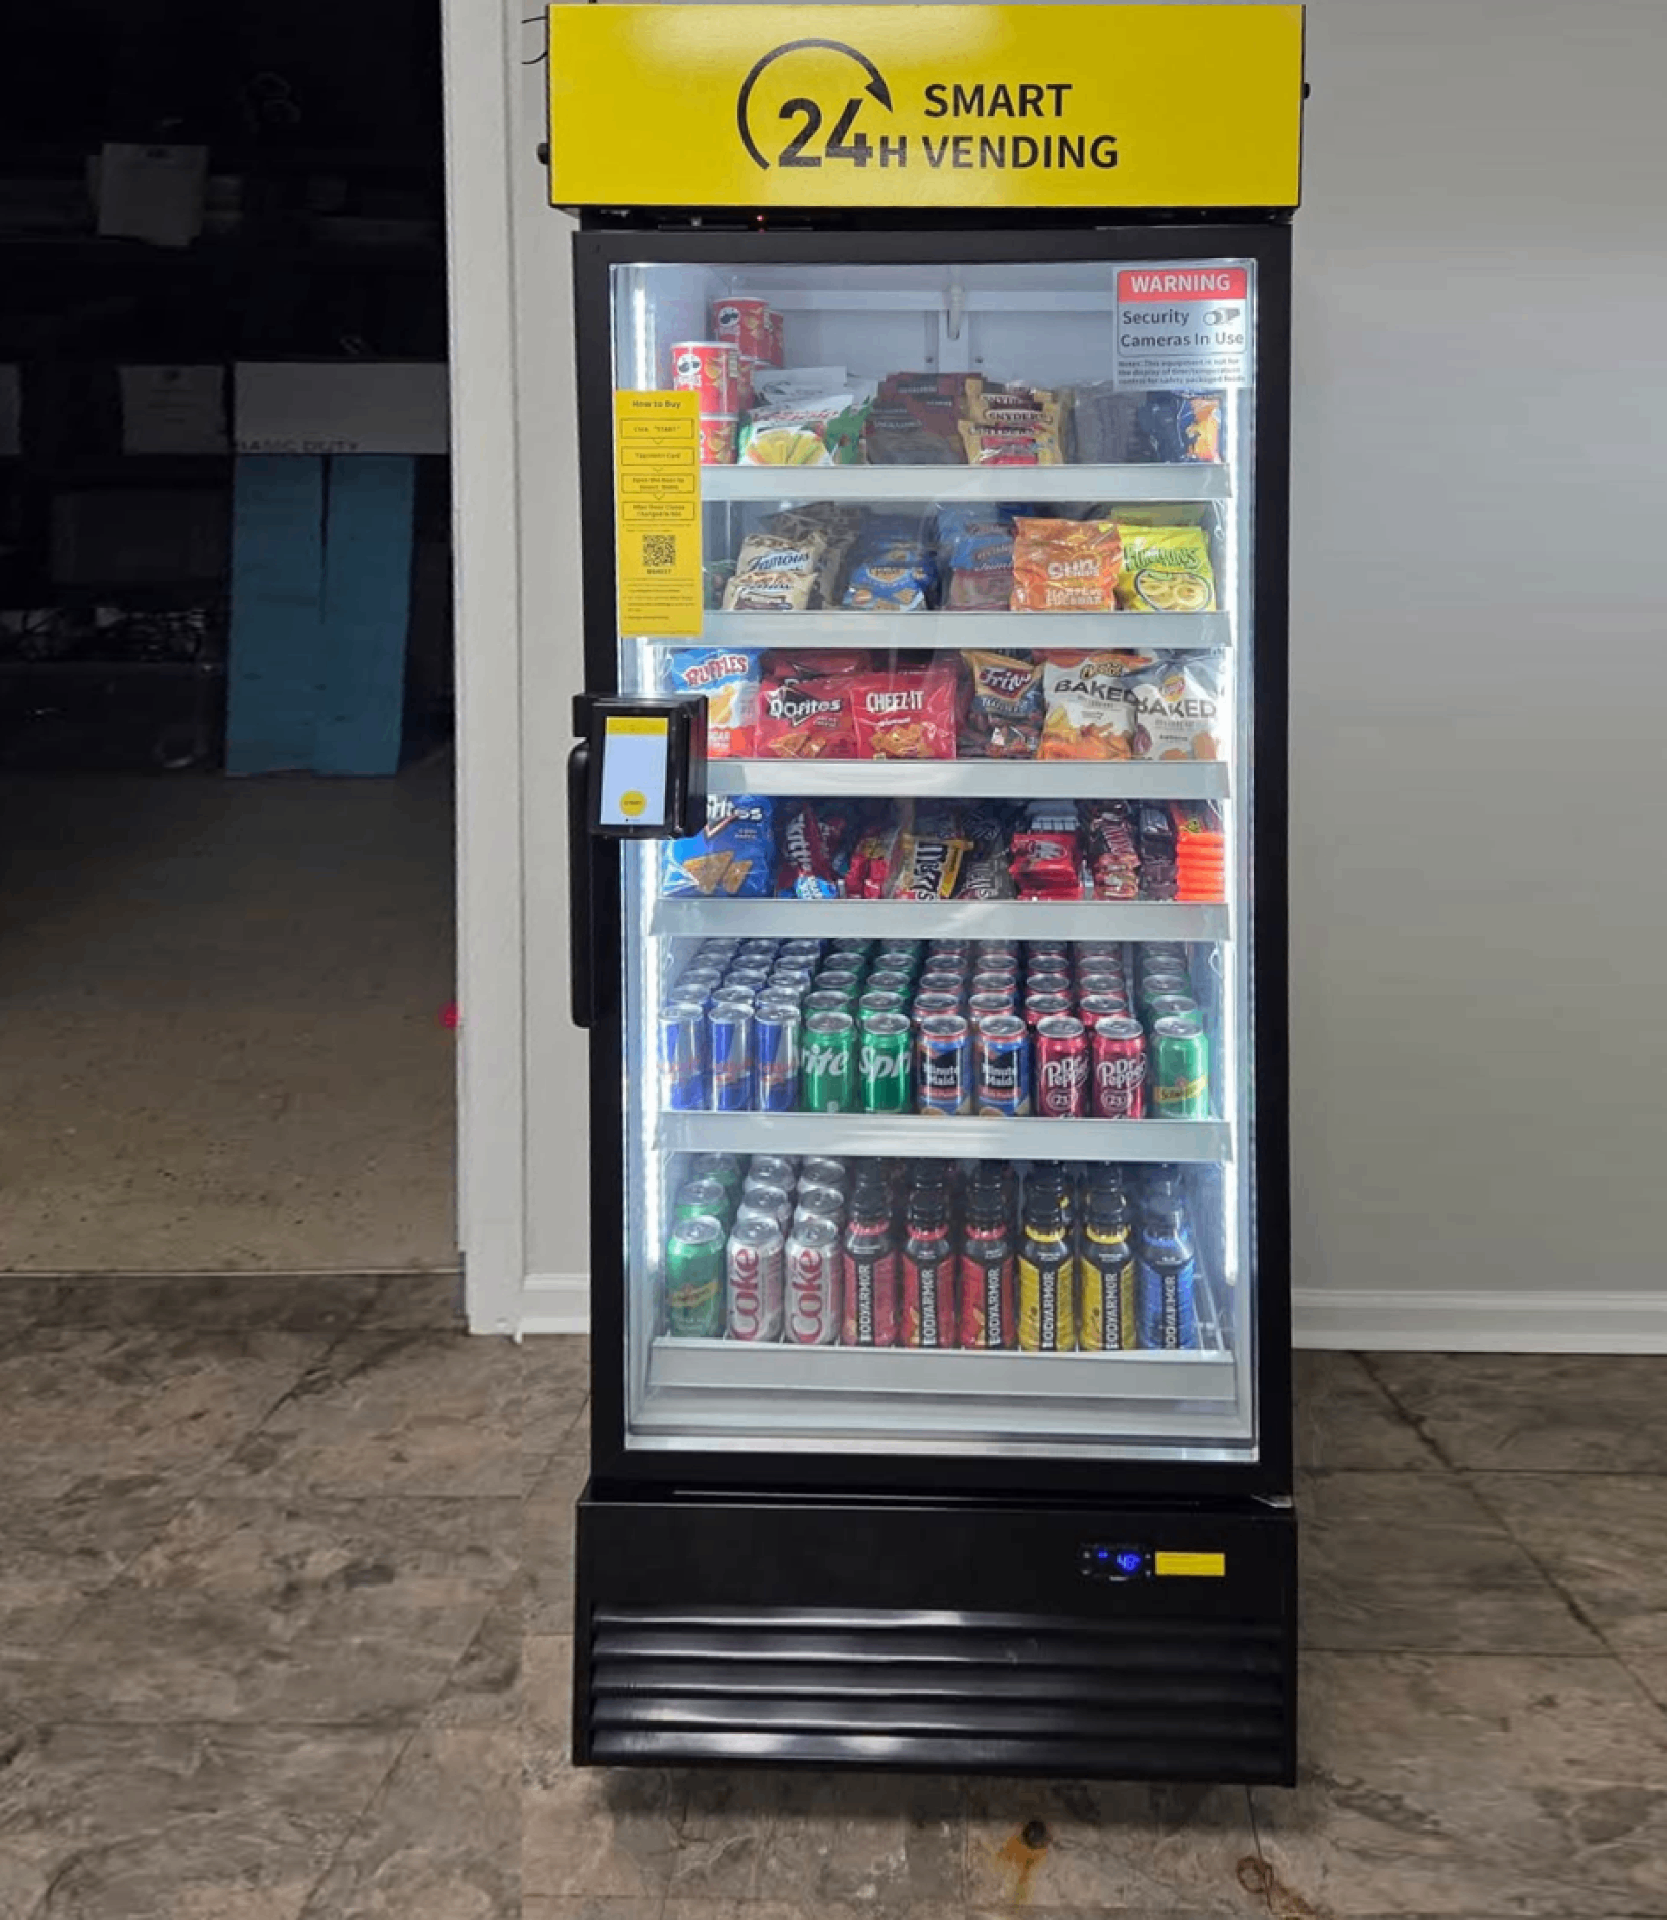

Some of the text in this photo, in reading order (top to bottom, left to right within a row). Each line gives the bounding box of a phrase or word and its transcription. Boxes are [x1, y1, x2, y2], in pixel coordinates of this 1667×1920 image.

[923, 83, 1073, 118] SMART
[922, 135, 1118, 169] VENDING
[1130, 273, 1231, 293] WARNING
[1123, 309, 1190, 326] Security
[1120, 331, 1244, 347] Cameras In Use
[632, 400, 681, 409] How to Buy
[748, 552, 810, 571] Famous
[684, 654, 749, 686] RUFFLES
[866, 690, 925, 712] CHEEZ-IT
[1054, 679, 1139, 706] BAKED
[768, 696, 841, 718] Doritos
[707, 795, 763, 820] ritos
[801, 1044, 850, 1076] rite
[729, 1248, 760, 1341] Coke
[791, 1249, 823, 1343] Coke
